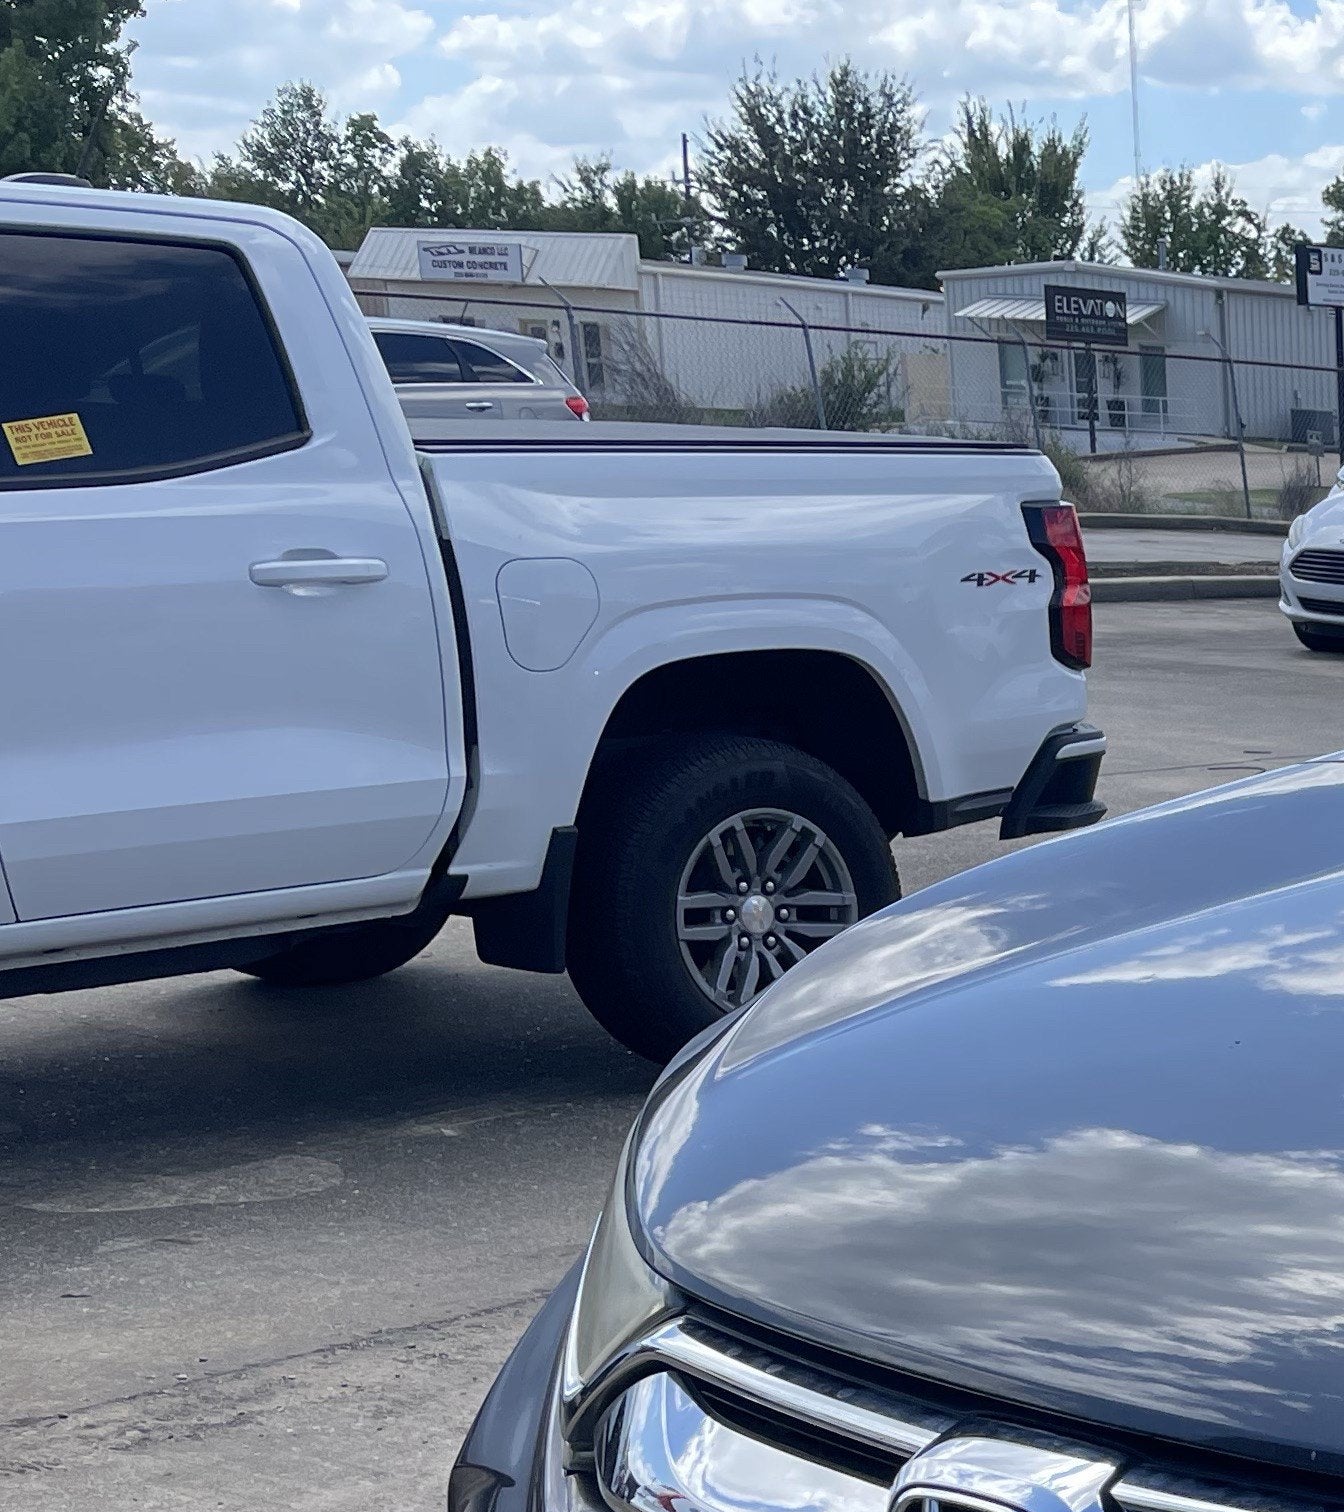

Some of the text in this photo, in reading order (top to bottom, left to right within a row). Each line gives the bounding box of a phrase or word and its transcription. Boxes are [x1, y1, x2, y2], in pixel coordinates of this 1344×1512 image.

[431, 260, 509, 271] CUSTOM CONCRETE
[1055, 295, 1125, 319] ELEVATION
[8, 416, 76, 435] THIS VEHICLE
[15, 428, 77, 443] NOT FOR SALE
